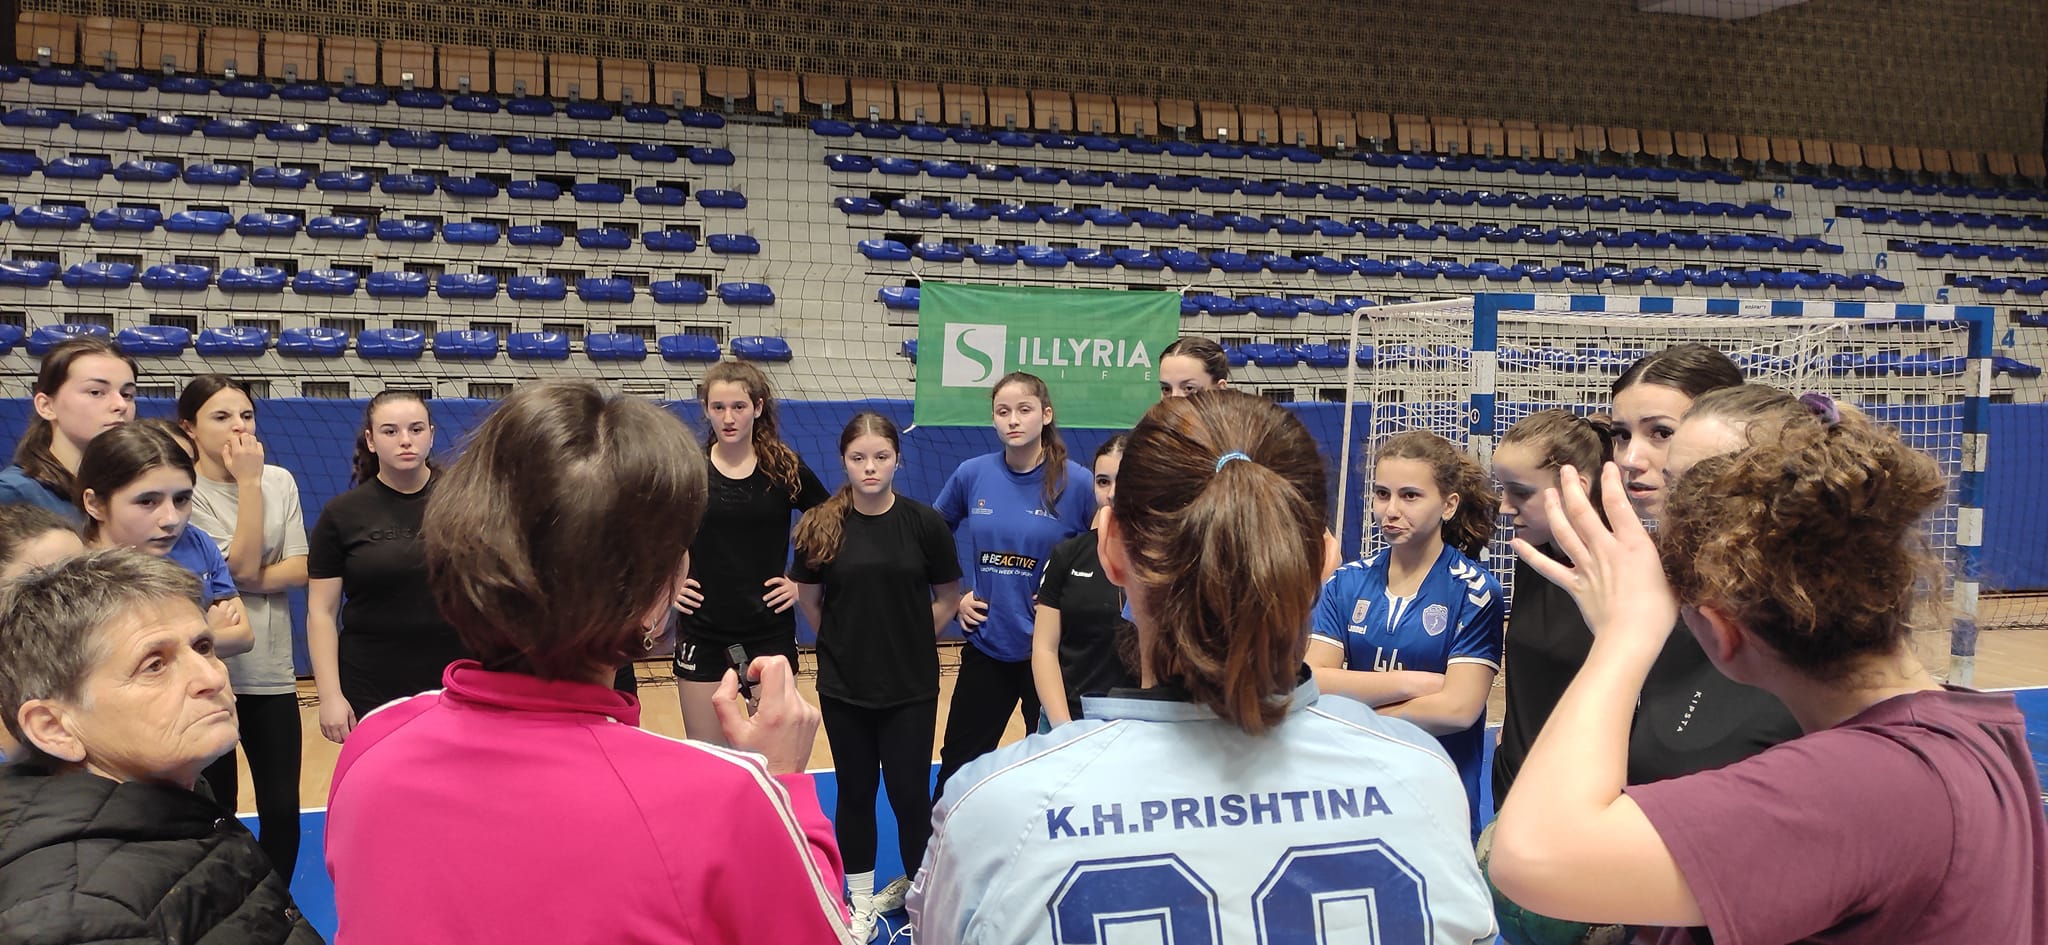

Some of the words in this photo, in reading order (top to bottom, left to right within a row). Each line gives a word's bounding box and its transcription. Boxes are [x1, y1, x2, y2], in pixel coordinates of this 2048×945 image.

[1773, 184, 1785, 199] 8
[125, 209, 139, 217] 07
[597, 228, 609, 236] 14
[1823, 218, 1836, 234] 7
[99, 263, 113, 271] 07
[1875, 252, 1888, 270] 6
[1935, 287, 1950, 304] 5
[66, 325, 81, 334] 07
[310, 328, 322, 337] 10
[460, 331, 473, 339] 12
[532, 333, 544, 341] 13
[2001, 328, 2016, 348] 4
[1018, 336, 1152, 368] ILLYRIA
[981, 552, 1037, 570] #BEACTIVE
[1676, 690, 1703, 733] KIPSTA
[1045, 785, 1393, 841] K.H.PRISHTINA
